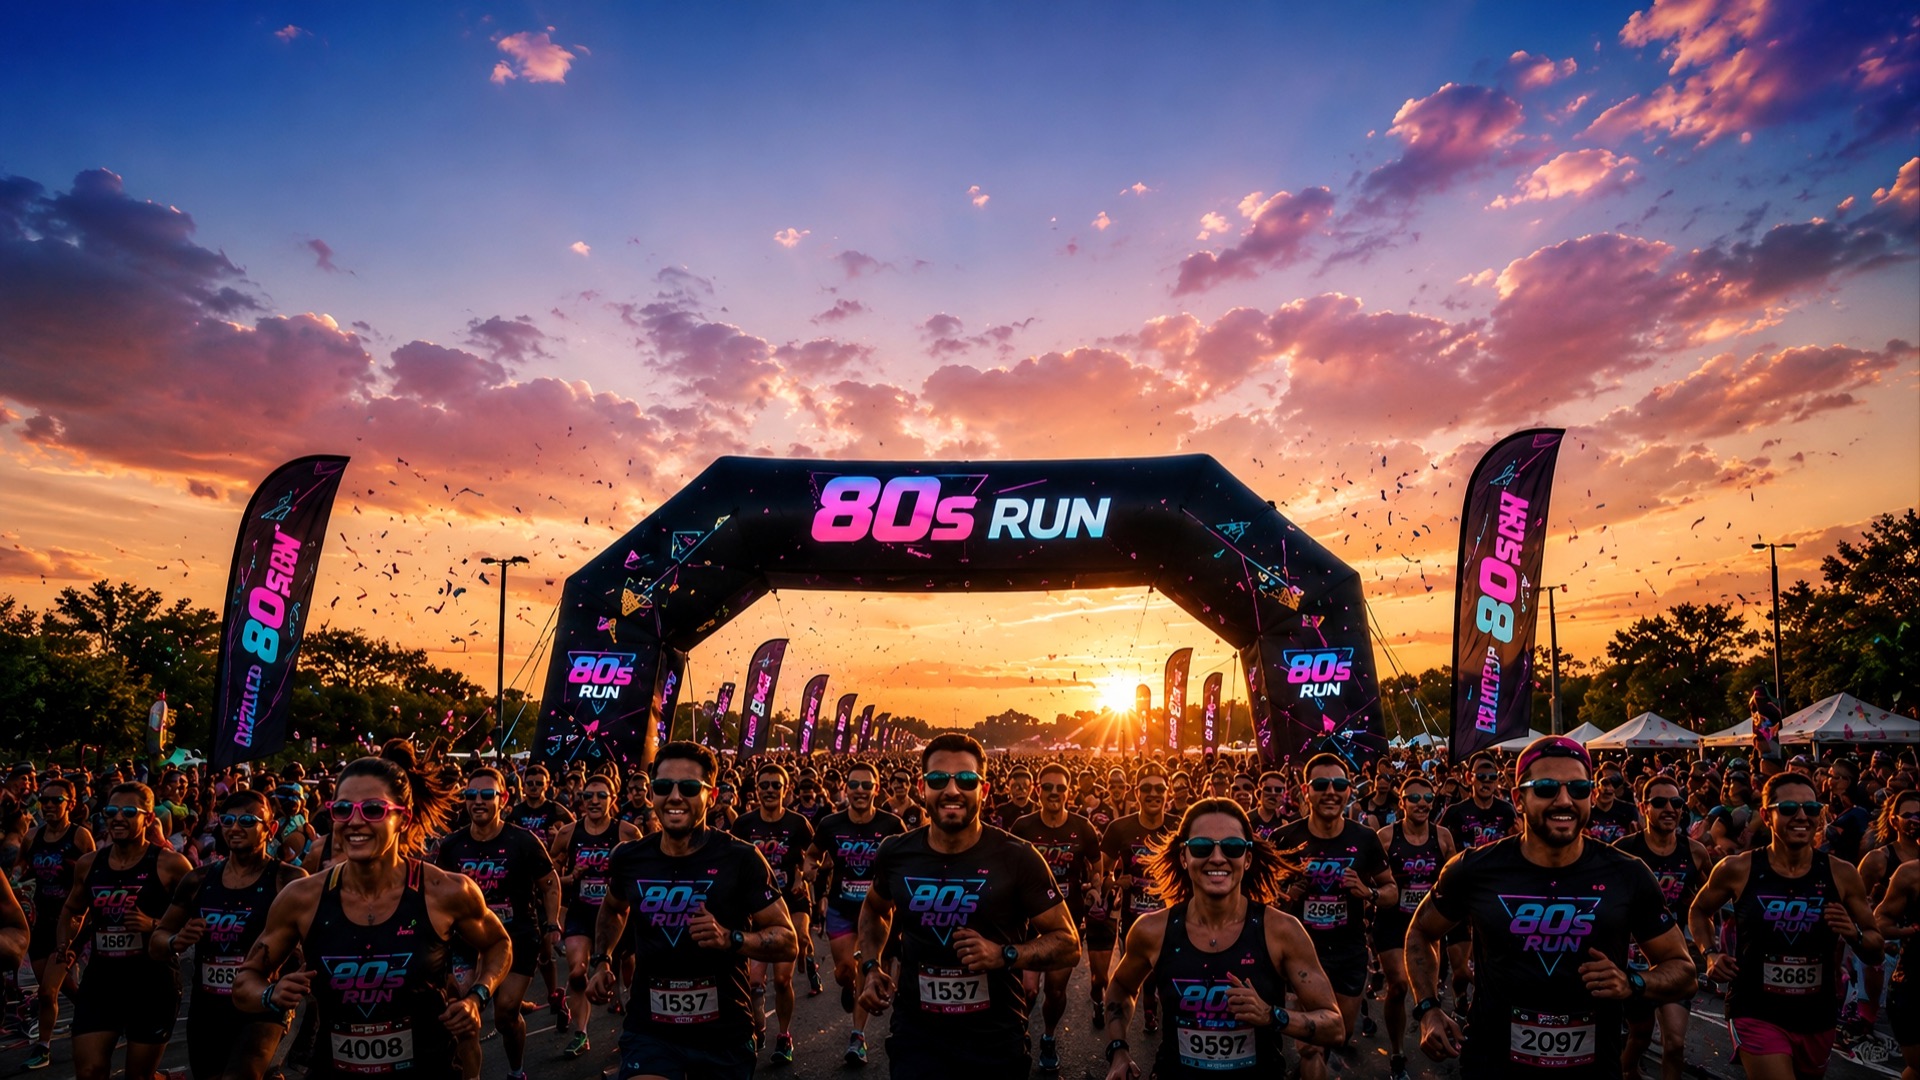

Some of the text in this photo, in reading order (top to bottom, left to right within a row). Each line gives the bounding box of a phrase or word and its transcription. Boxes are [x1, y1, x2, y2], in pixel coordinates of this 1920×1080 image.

[810, 476, 1111, 542] 80s RUN
[568, 656, 634, 686] 80s
[1287, 653, 1352, 684] 80s
[578, 684, 620, 699] RUN
[1299, 682, 1341, 699] RUN
[93, 889, 138, 907] 80s
[640, 886, 707, 913] 80s
[909, 884, 980, 912] 80s
[920, 912, 968, 927] RUN
[1509, 903, 1596, 936] 80s
[1764, 900, 1822, 922] 80s
[210, 932, 238, 942] RUN
[1773, 920, 1812, 933] RUN
[1523, 935, 1582, 952] RUN
[207, 968, 239, 984] 266
[330, 961, 407, 990] 80s
[342, 989, 393, 1004] RUN
[927, 980, 980, 1001] 1537
[1179, 985, 1232, 1011] 80
[658, 992, 708, 1012] 1537
[338, 1037, 404, 1060] 4008
[1189, 1033, 1248, 1056] 9597
[1520, 1029, 1587, 1053] 2097
